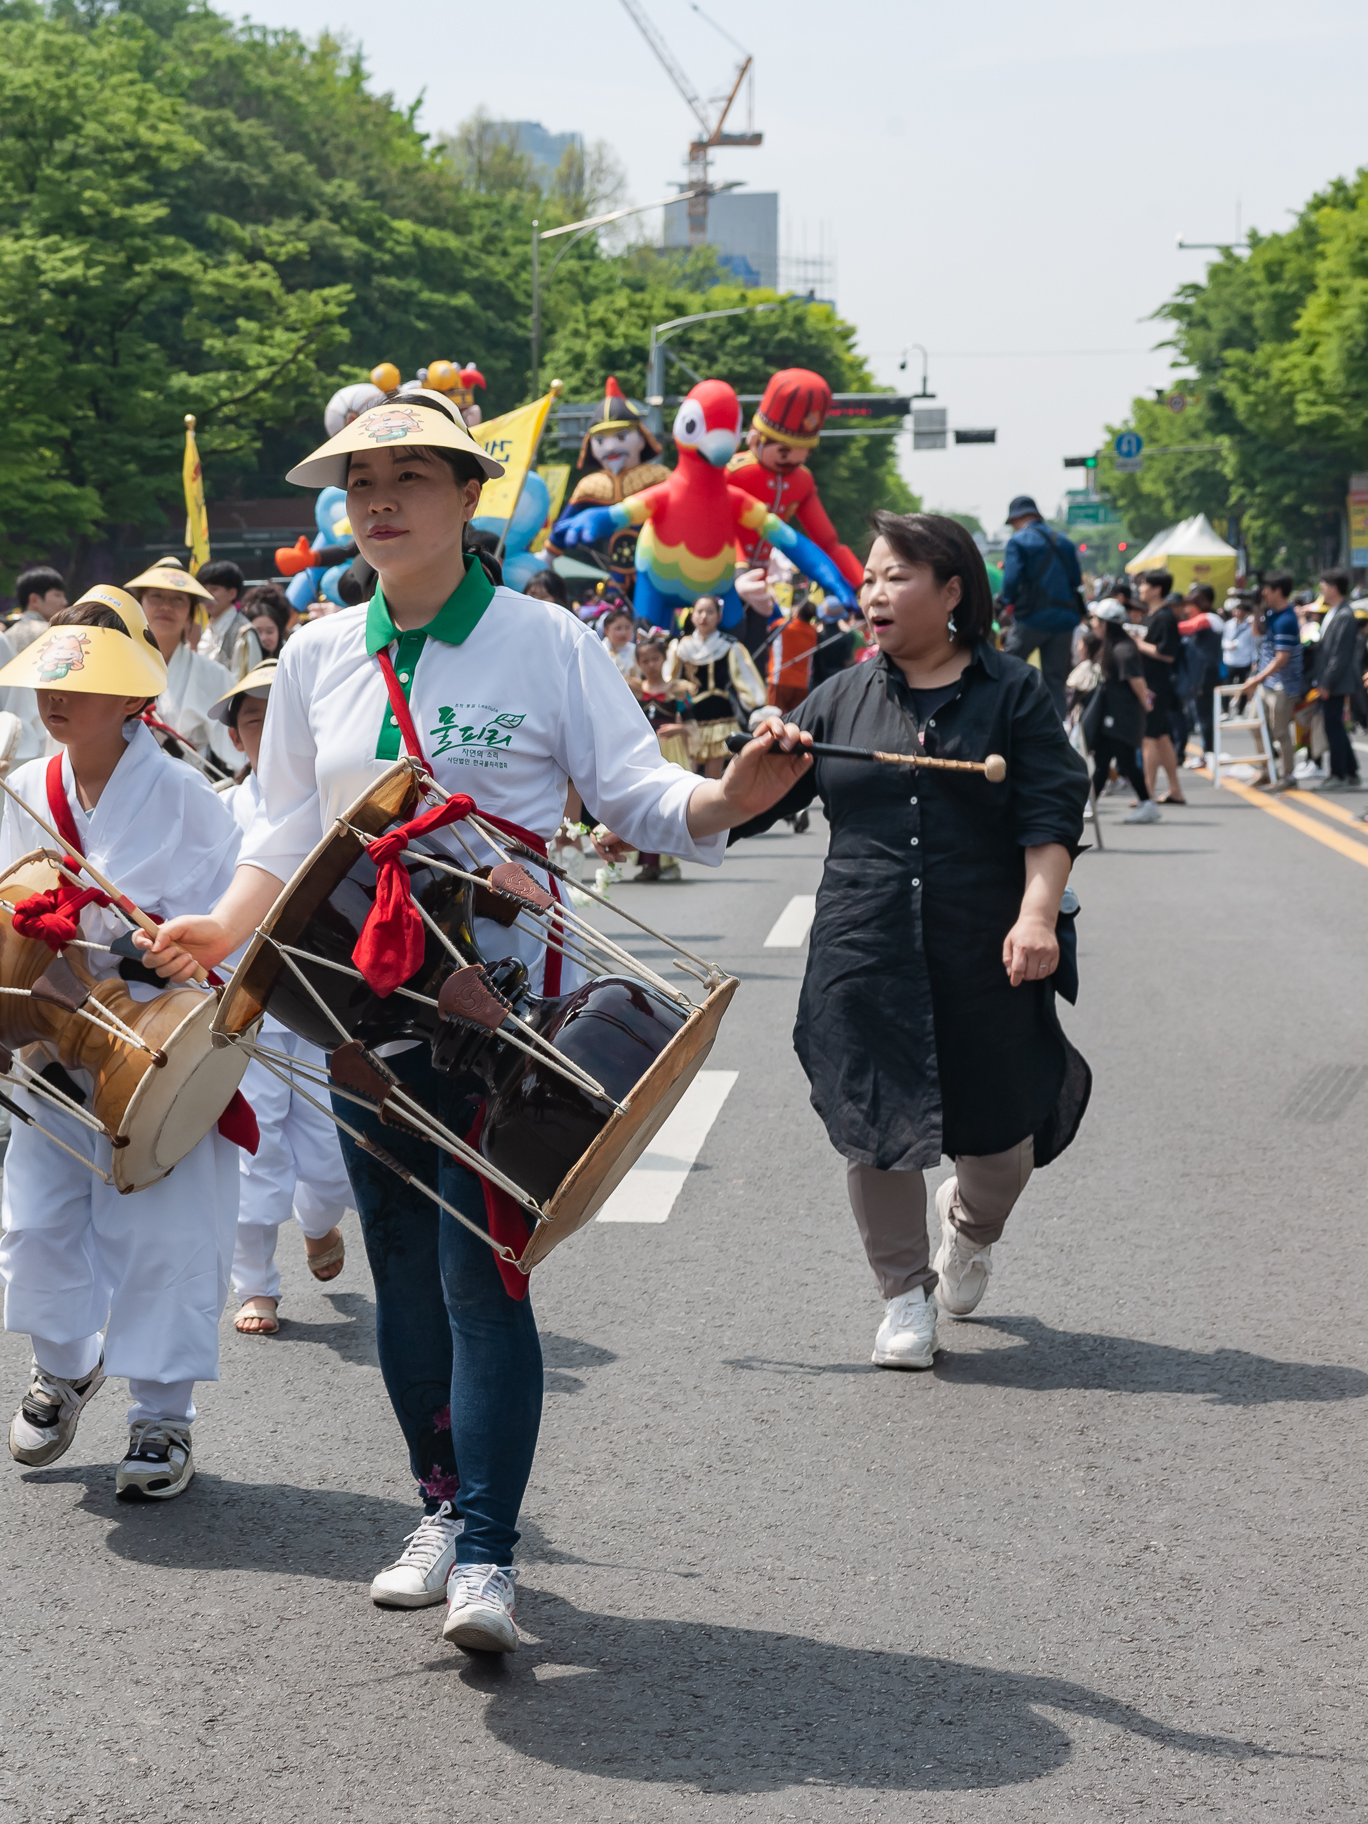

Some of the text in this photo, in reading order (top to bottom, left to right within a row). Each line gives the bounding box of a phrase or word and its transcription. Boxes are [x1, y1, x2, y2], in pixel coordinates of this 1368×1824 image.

[430, 706, 512, 752] 풀피리
[461, 747, 499, 760] 자연의 소리
[447, 757, 508, 769] 사단법인 한국풀피리협회
